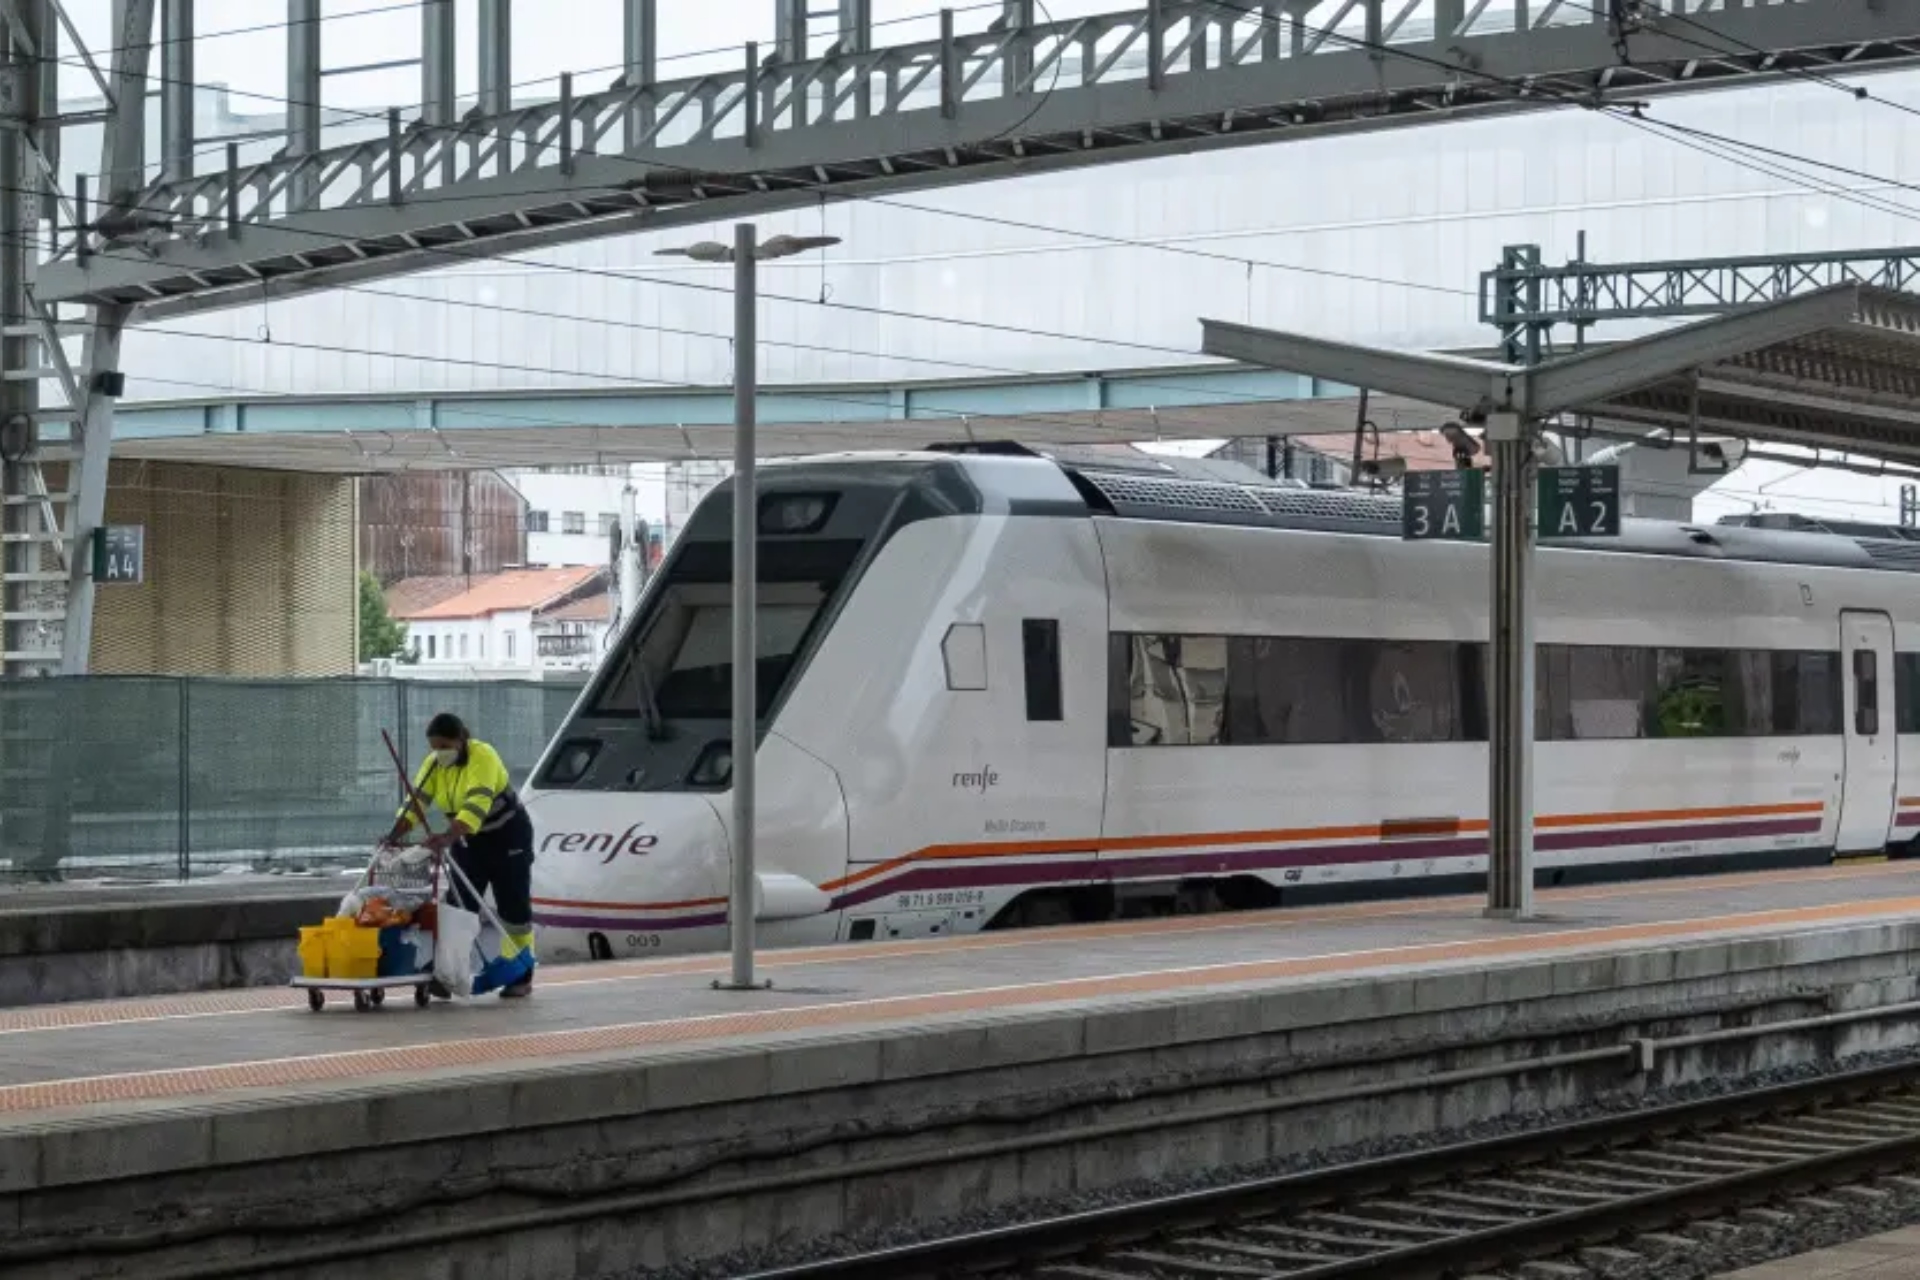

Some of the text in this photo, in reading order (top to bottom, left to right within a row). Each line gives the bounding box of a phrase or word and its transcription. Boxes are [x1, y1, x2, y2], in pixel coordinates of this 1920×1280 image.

[1413, 503, 1460, 536] 3 A
[1558, 501, 1606, 533] A 2
[107, 554, 134, 578] A 4
[952, 763, 999, 795] renfe
[540, 821, 659, 864] renfe
[626, 934, 662, 947] 009
